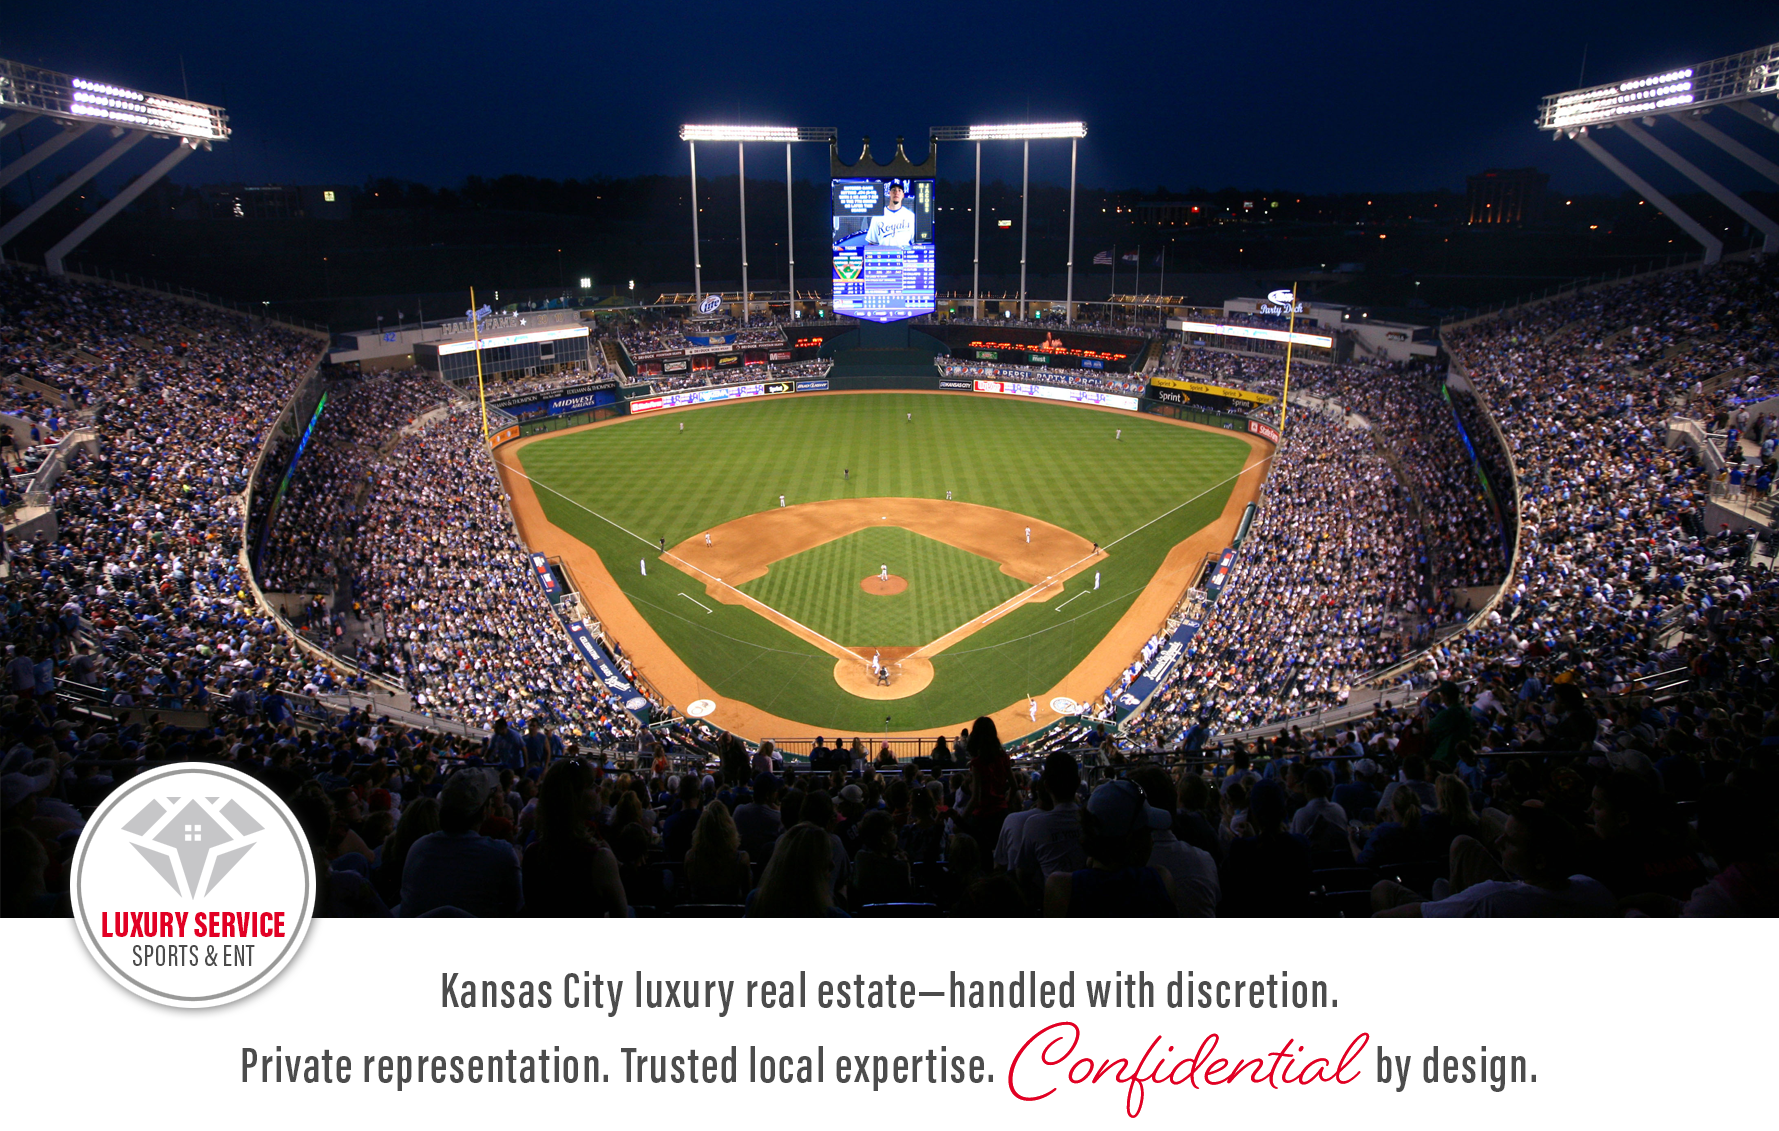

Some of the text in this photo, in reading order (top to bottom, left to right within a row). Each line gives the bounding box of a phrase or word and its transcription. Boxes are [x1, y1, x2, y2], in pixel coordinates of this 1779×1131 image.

[704, 300, 720, 312] Lite
[1260, 302, 1303, 316] Party Dck
[485, 317, 517, 330] FAME
[592, 383, 616, 392] THOMPSON
[512, 396, 537, 405] THOMPSON
[553, 395, 594, 408] MIDWEST
[1159, 391, 1181, 403] Sprint
[1232, 399, 1250, 409] Sprint
